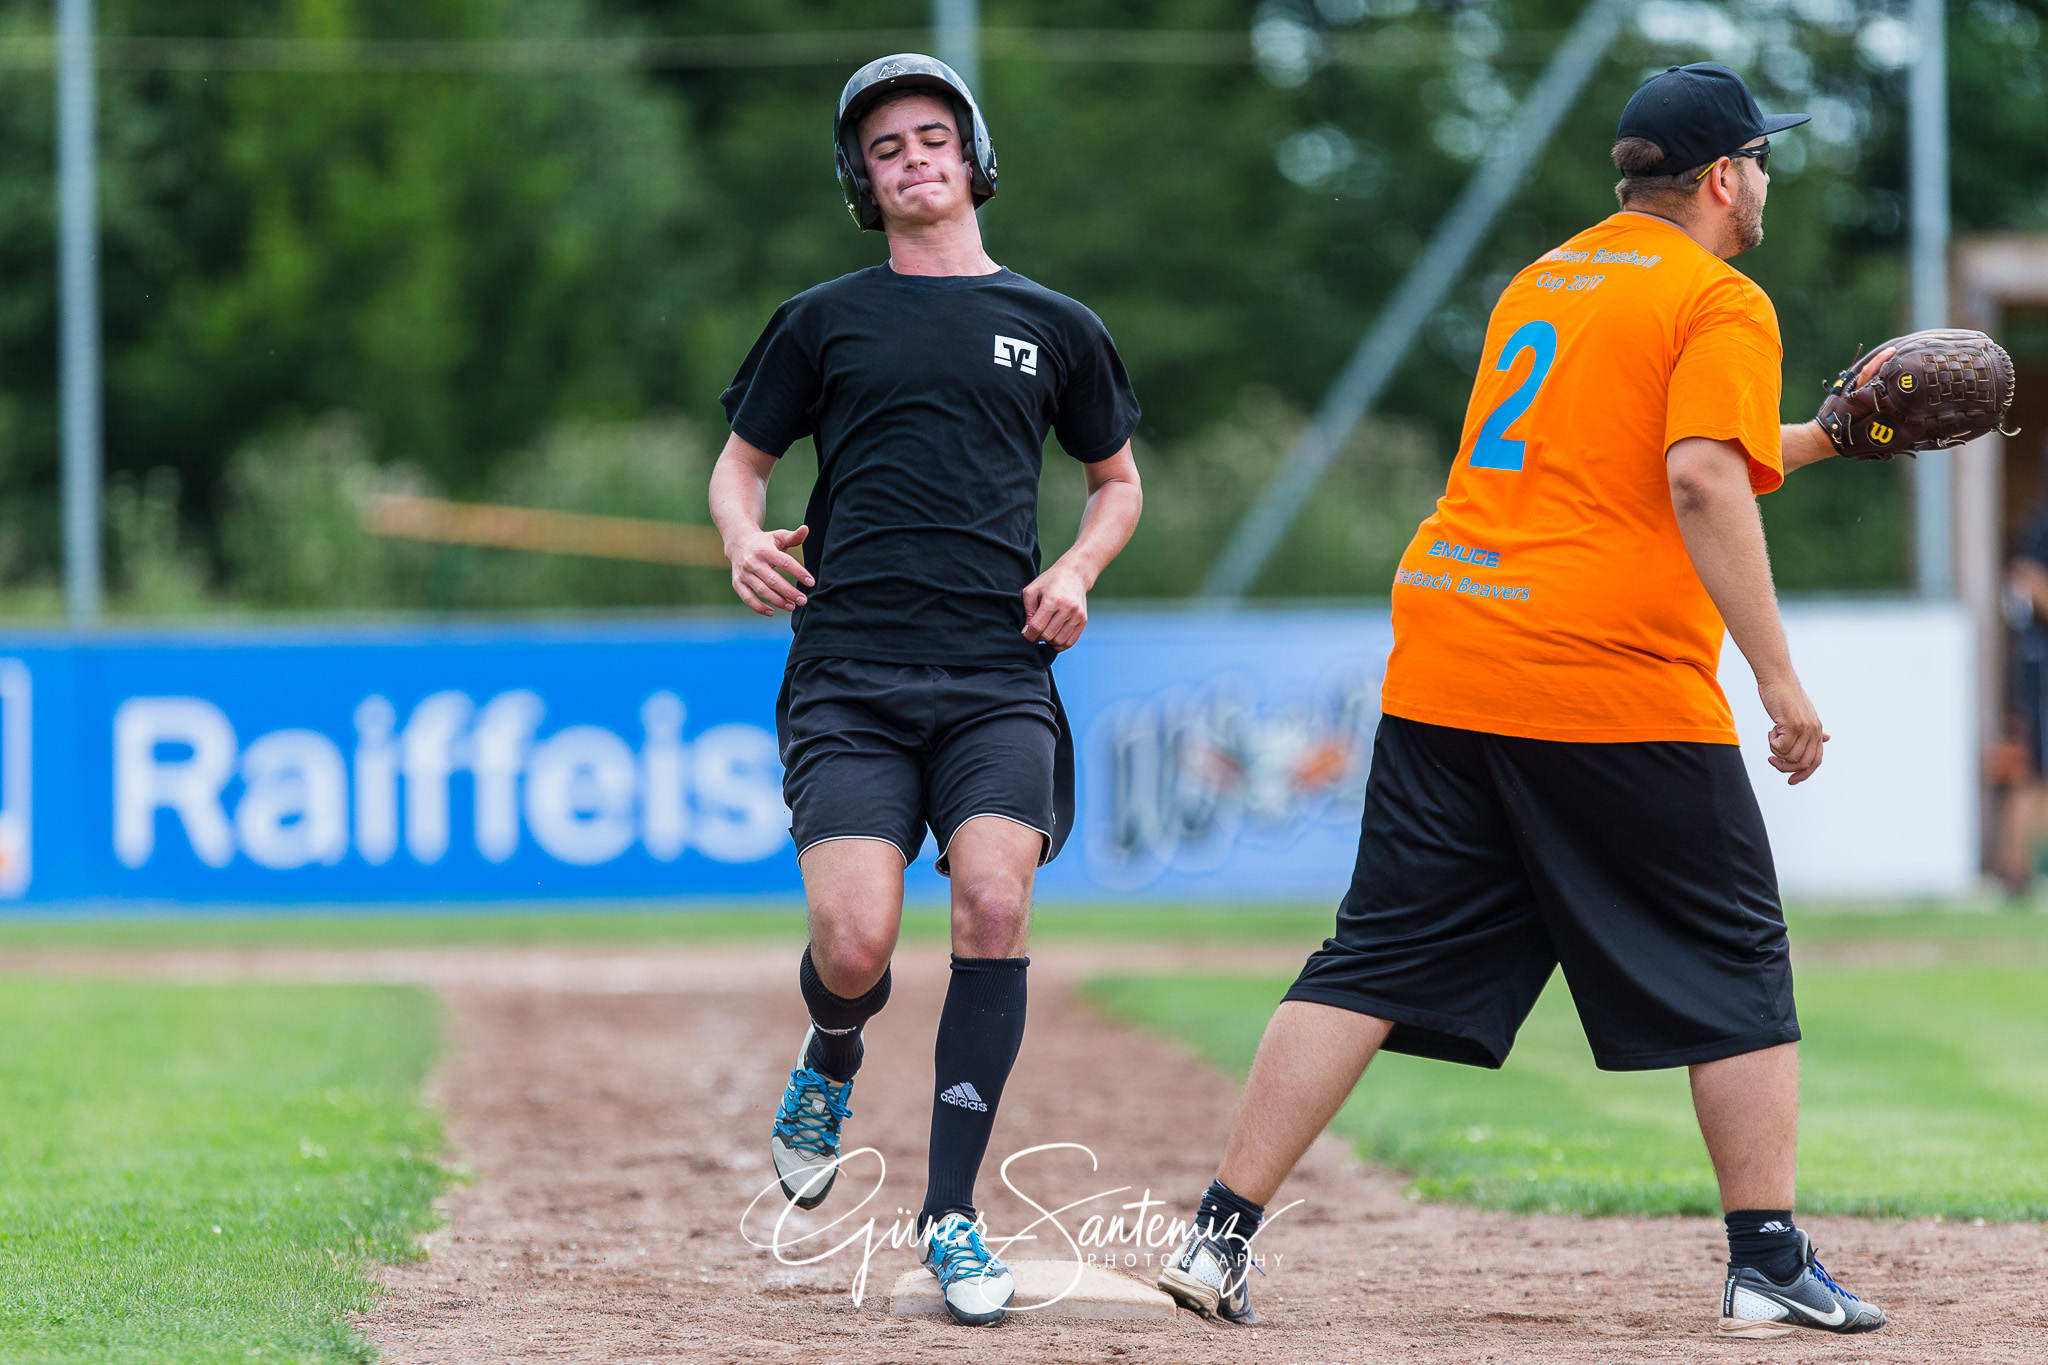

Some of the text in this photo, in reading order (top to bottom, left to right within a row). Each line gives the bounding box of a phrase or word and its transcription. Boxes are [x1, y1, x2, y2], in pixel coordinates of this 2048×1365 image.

[1591, 249, 1662, 268] Baseball
[1536, 272, 1605, 292] Cup 2017
[1469, 320, 1558, 471] 2
[1427, 540, 1501, 568] EMUGE
[1456, 577, 1531, 600] Beavers
[940, 1092, 988, 1112] adidas
